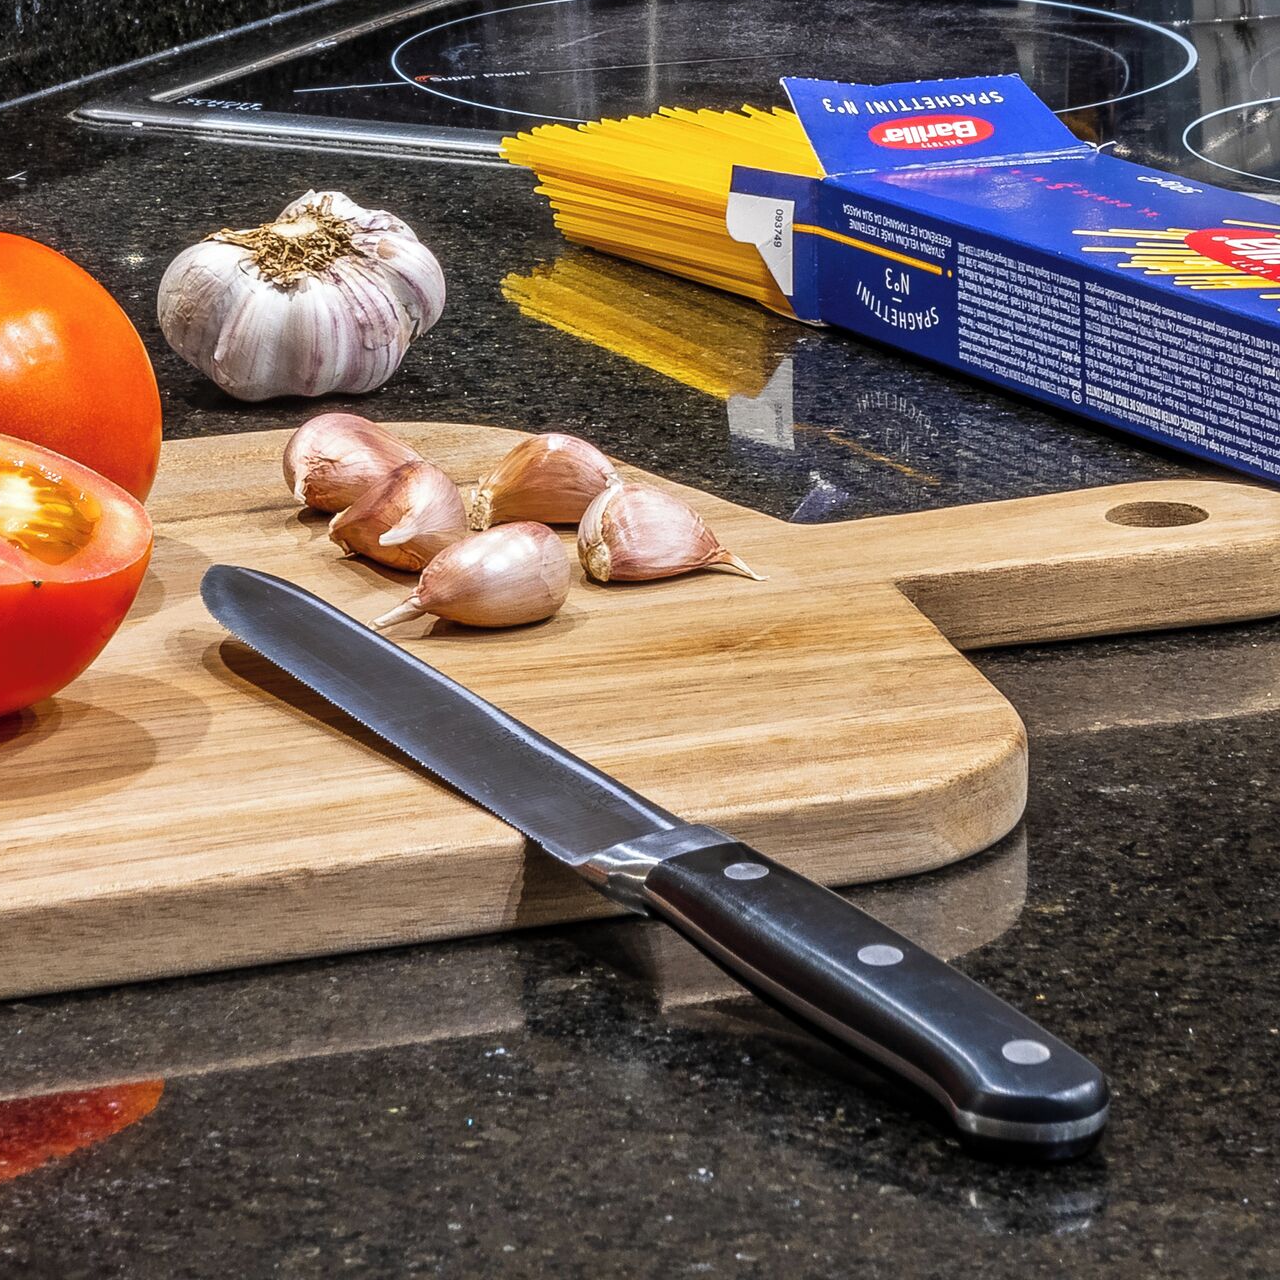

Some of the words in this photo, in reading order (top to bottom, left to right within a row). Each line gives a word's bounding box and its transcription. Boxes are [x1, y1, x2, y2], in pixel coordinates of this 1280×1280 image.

[868, 90, 1005, 116] SPAGHETTINI
[886, 120, 978, 145] Barilla
[773, 207, 785, 248] 093749
[884, 266, 911, 293] N°3
[856, 280, 940, 332] SPAGHETTINI
